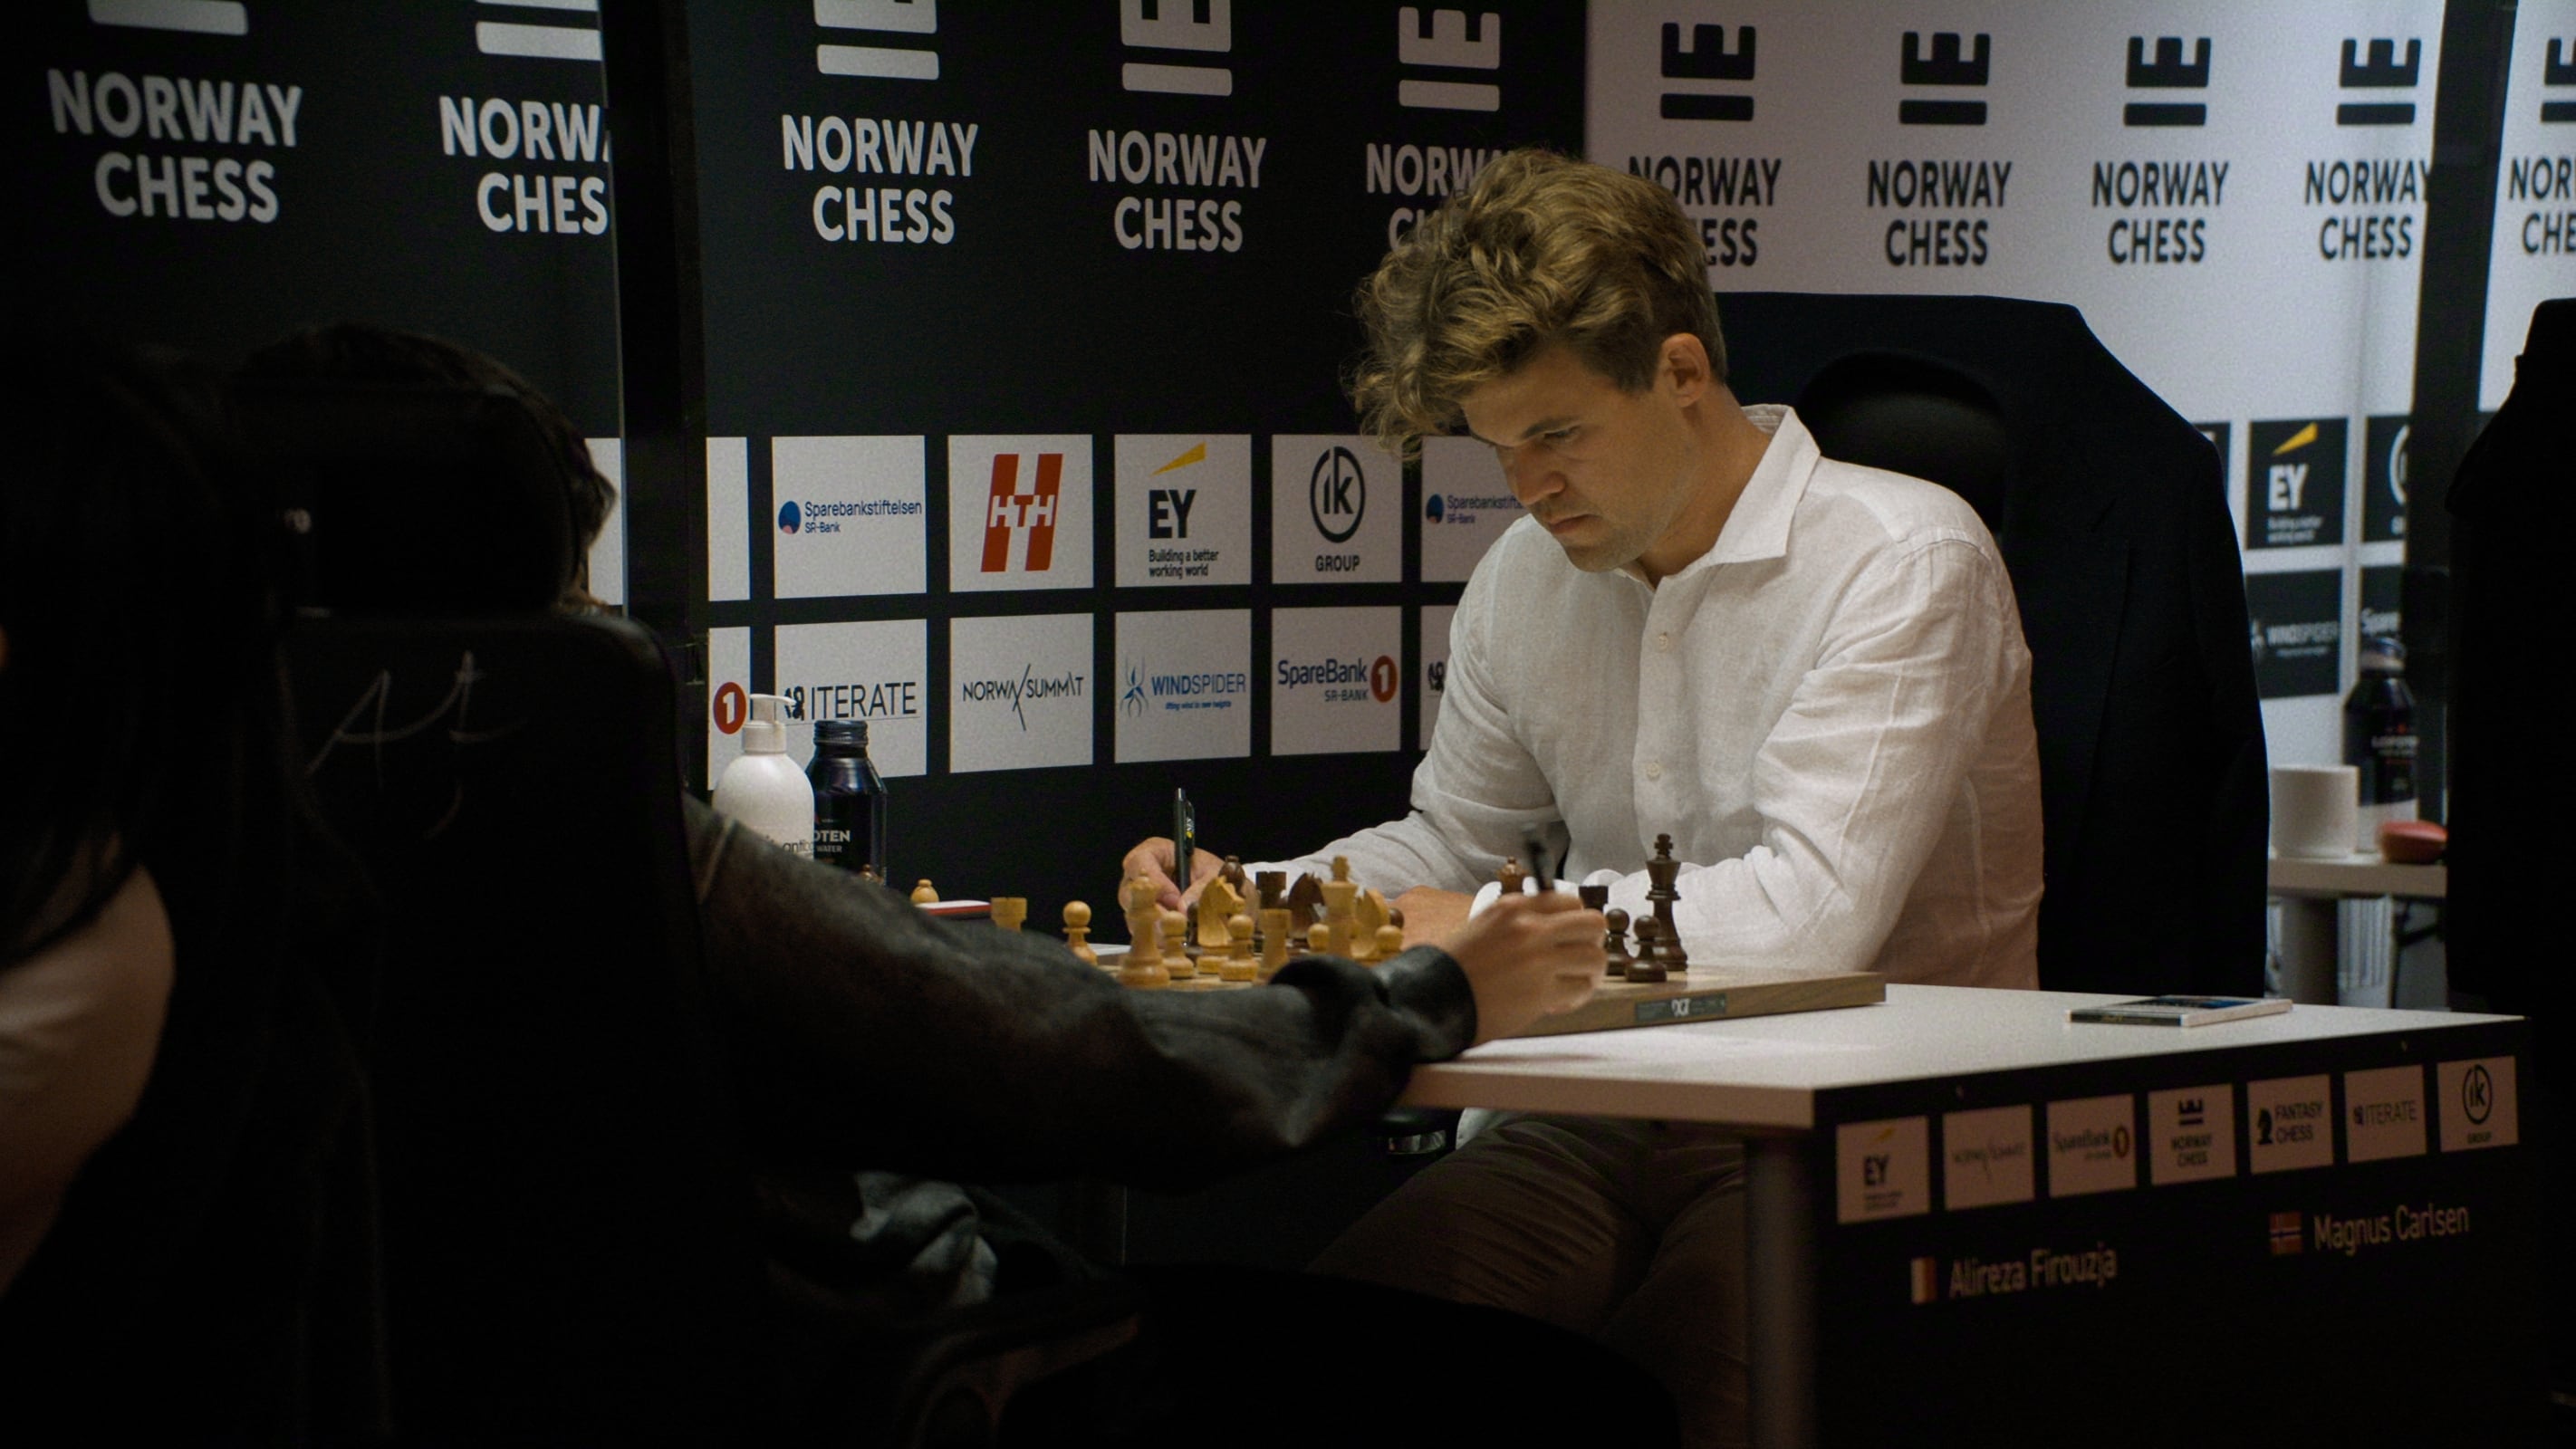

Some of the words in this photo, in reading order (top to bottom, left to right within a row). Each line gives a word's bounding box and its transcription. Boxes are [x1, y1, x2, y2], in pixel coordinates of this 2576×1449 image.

[47, 69, 302, 147] NORWAY
[439, 95, 609, 162] NORW
[782, 114, 978, 177] NORWAY
[1089, 129, 1266, 188] NORWAY
[95, 151, 279, 223] CHESS
[1366, 142, 1513, 196] NORW
[1868, 160, 2013, 207] NORWAY
[2091, 161, 2230, 207] NORWAY
[2508, 157, 2576, 199] NOR
[476, 172, 609, 235] CHES
[813, 186, 955, 244] CHESS
[1114, 197, 1243, 252] CHESS
[1702, 218, 1757, 265] ESS
[1886, 220, 1988, 265] CHESS
[2108, 219, 2206, 264] CHESS
[2320, 216, 2412, 260] CHESS
[2523, 213, 2576, 253] CHE
[2268, 463, 2308, 511] EY
[804, 500, 922, 521] Sparebankstiftelsen
[804, 522, 841, 533] SR-Bank
[1149, 489, 1197, 539] EY
[1149, 549, 1184, 564] Building
[1186, 552, 1191, 561] a
[1193, 549, 1219, 561] better
[1149, 564, 1183, 579] working
[1186, 563, 1209, 576] world
[1315, 554, 1360, 572] GROUP
[1152, 674, 1246, 696] WINDSPIDER
[1278, 657, 1368, 688] SpareBank
[812, 682, 917, 720] ITERATE
[1325, 689, 1369, 702] SR-BANK
[2274, 1100, 2323, 1120] FANTASY
[2366, 1099, 2417, 1125] ITERATE
[2276, 1125, 2314, 1144] CHESS
[1864, 1155, 1889, 1185] EY
[2313, 1213, 2392, 1258] Magnus
[2395, 1203, 2470, 1242] Carlsen
[1949, 1256, 2028, 1300] Alireza
[2030, 1240, 2119, 1290] Firouzja
